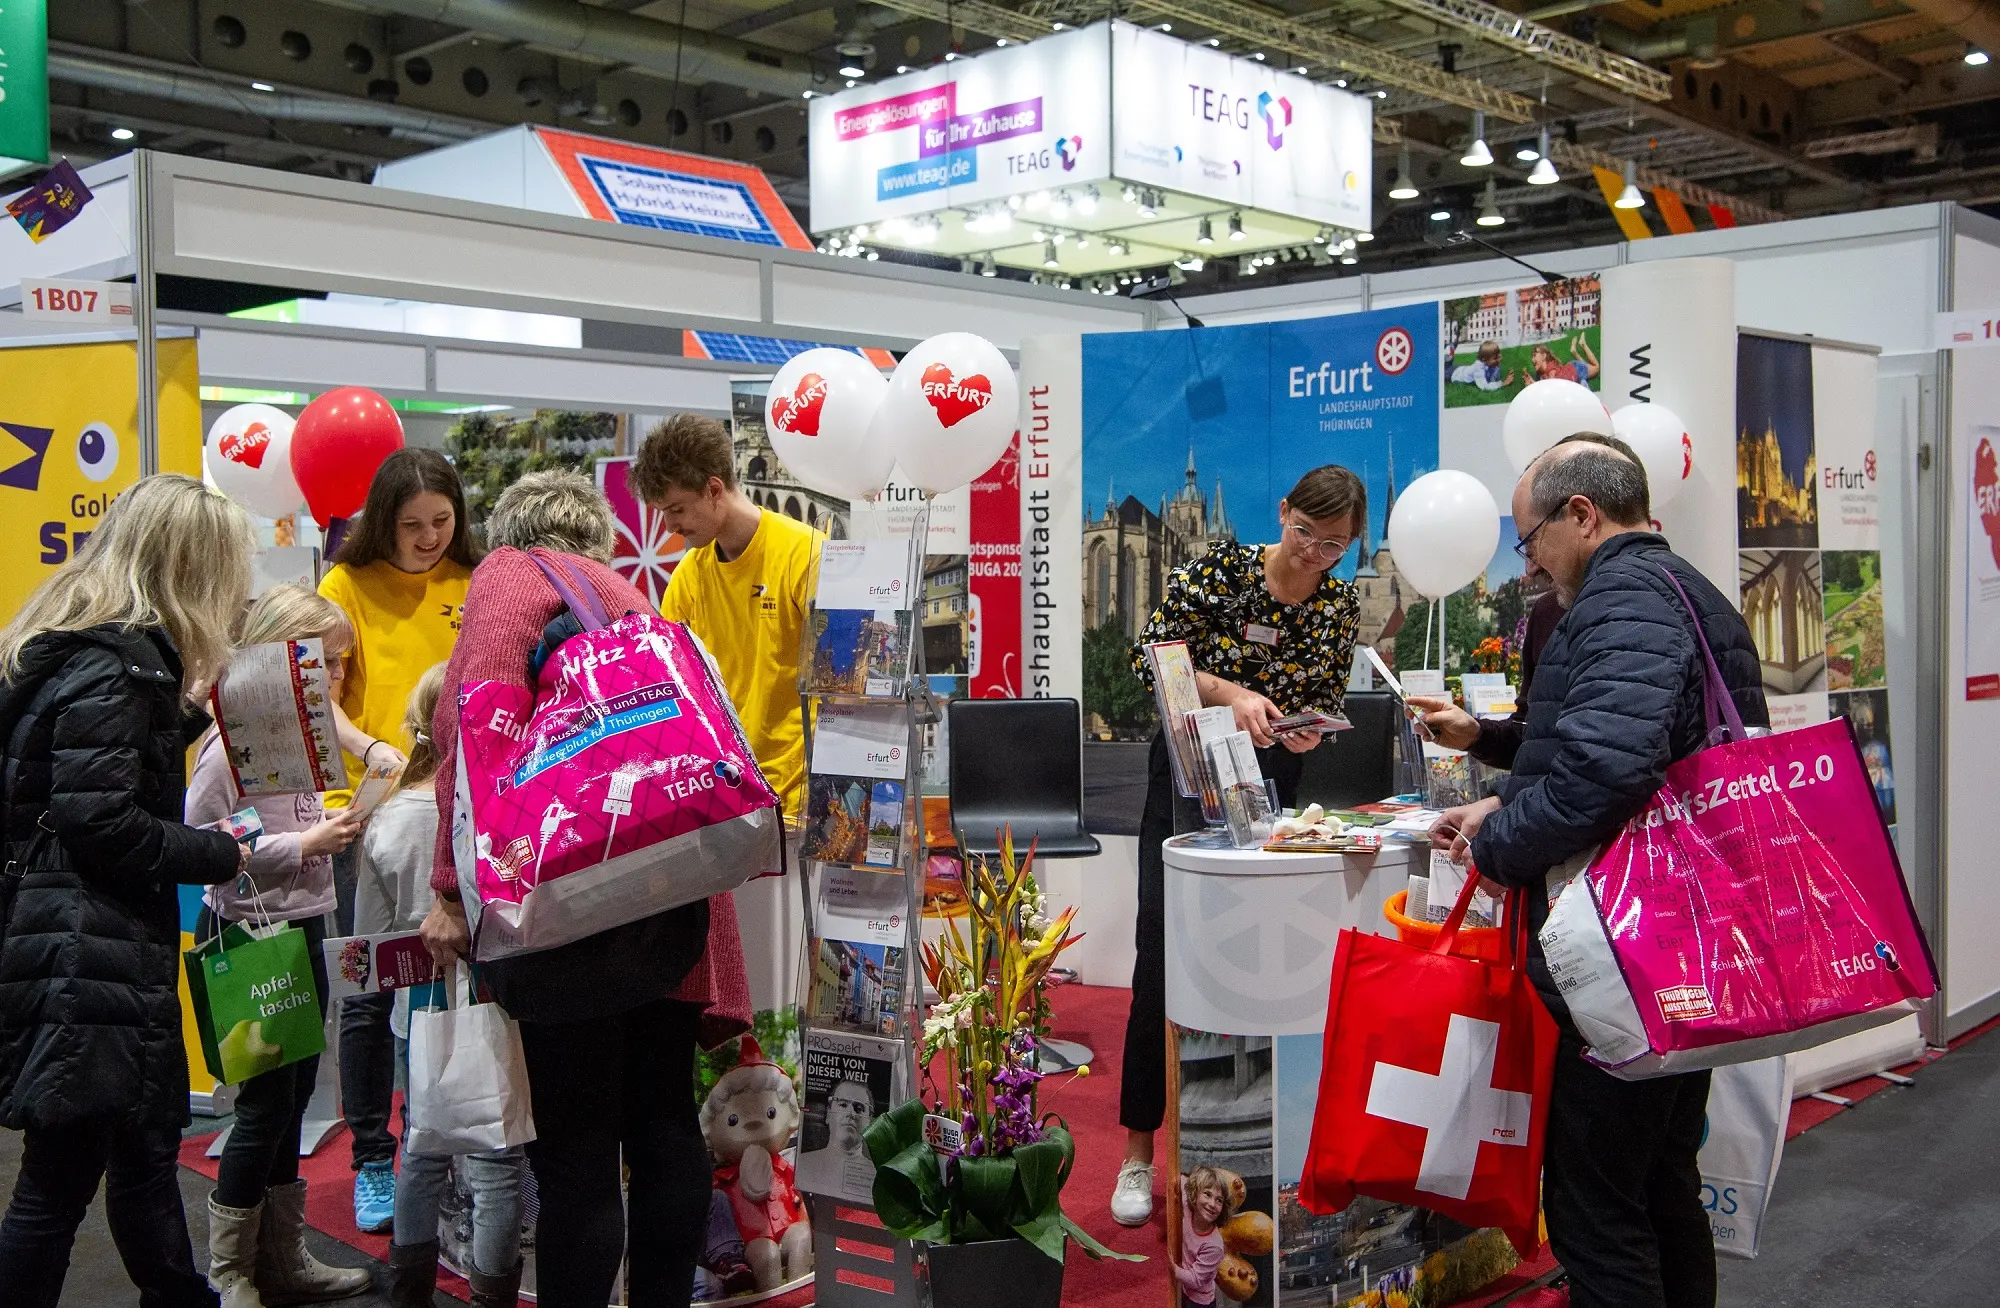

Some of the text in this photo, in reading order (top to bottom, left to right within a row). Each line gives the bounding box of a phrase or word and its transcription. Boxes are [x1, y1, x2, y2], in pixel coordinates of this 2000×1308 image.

[838, 94, 948, 134] Energielösungen
[1188, 83, 1250, 131] TEAG
[924, 109, 1036, 149] für Ihr Zuhause
[882, 157, 970, 192] www.teag.de
[1008, 149, 1049, 176] TEAG
[616, 174, 728, 203] Solarthermie
[614, 190, 754, 225] Hybrid-Heizung
[31, 287, 98, 313] 1B07
[1289, 361, 1373, 398] Erfurt
[777, 379, 828, 432] ERFURT
[924, 381, 993, 407] ERFURT
[1319, 395, 1414, 415] LANDESHAUPTSTADT
[1028, 384, 1049, 479] Erfurt
[1319, 417, 1373, 432] THÜRINGEN
[224, 430, 273, 460] ERFURT
[1825, 467, 1864, 489] Erfurt
[969, 562, 1001, 577] BUGA
[869, 586, 890, 595] Erfurt
[550, 703, 612, 745] Ausstellung
[613, 697, 638, 711] und
[639, 686, 674, 701] TEAG
[540, 736, 589, 768] Herzblut
[607, 704, 672, 731] Thüringen
[867, 752, 890, 763] Erfurt
[1788, 754, 1834, 789] 2.0
[663, 771, 715, 801] TEAG
[841, 888, 858, 896] Leben
[1776, 905, 1798, 918] Milch
[868, 920, 889, 931] Erfurt
[1656, 934, 1683, 951] Eier
[1831, 952, 1876, 979] TEAG
[251, 971, 299, 999] Apfel-
[1659, 987, 1707, 1003] THÜRINGEN
[259, 991, 311, 1017] tasche
[807, 1035, 861, 1055] PROspekt
[808, 1053, 866, 1071] NICHT VON
[808, 1065, 869, 1083] DIESER WELT
[943, 1127, 959, 1137] BUGA
[943, 1135, 959, 1144] 2021
